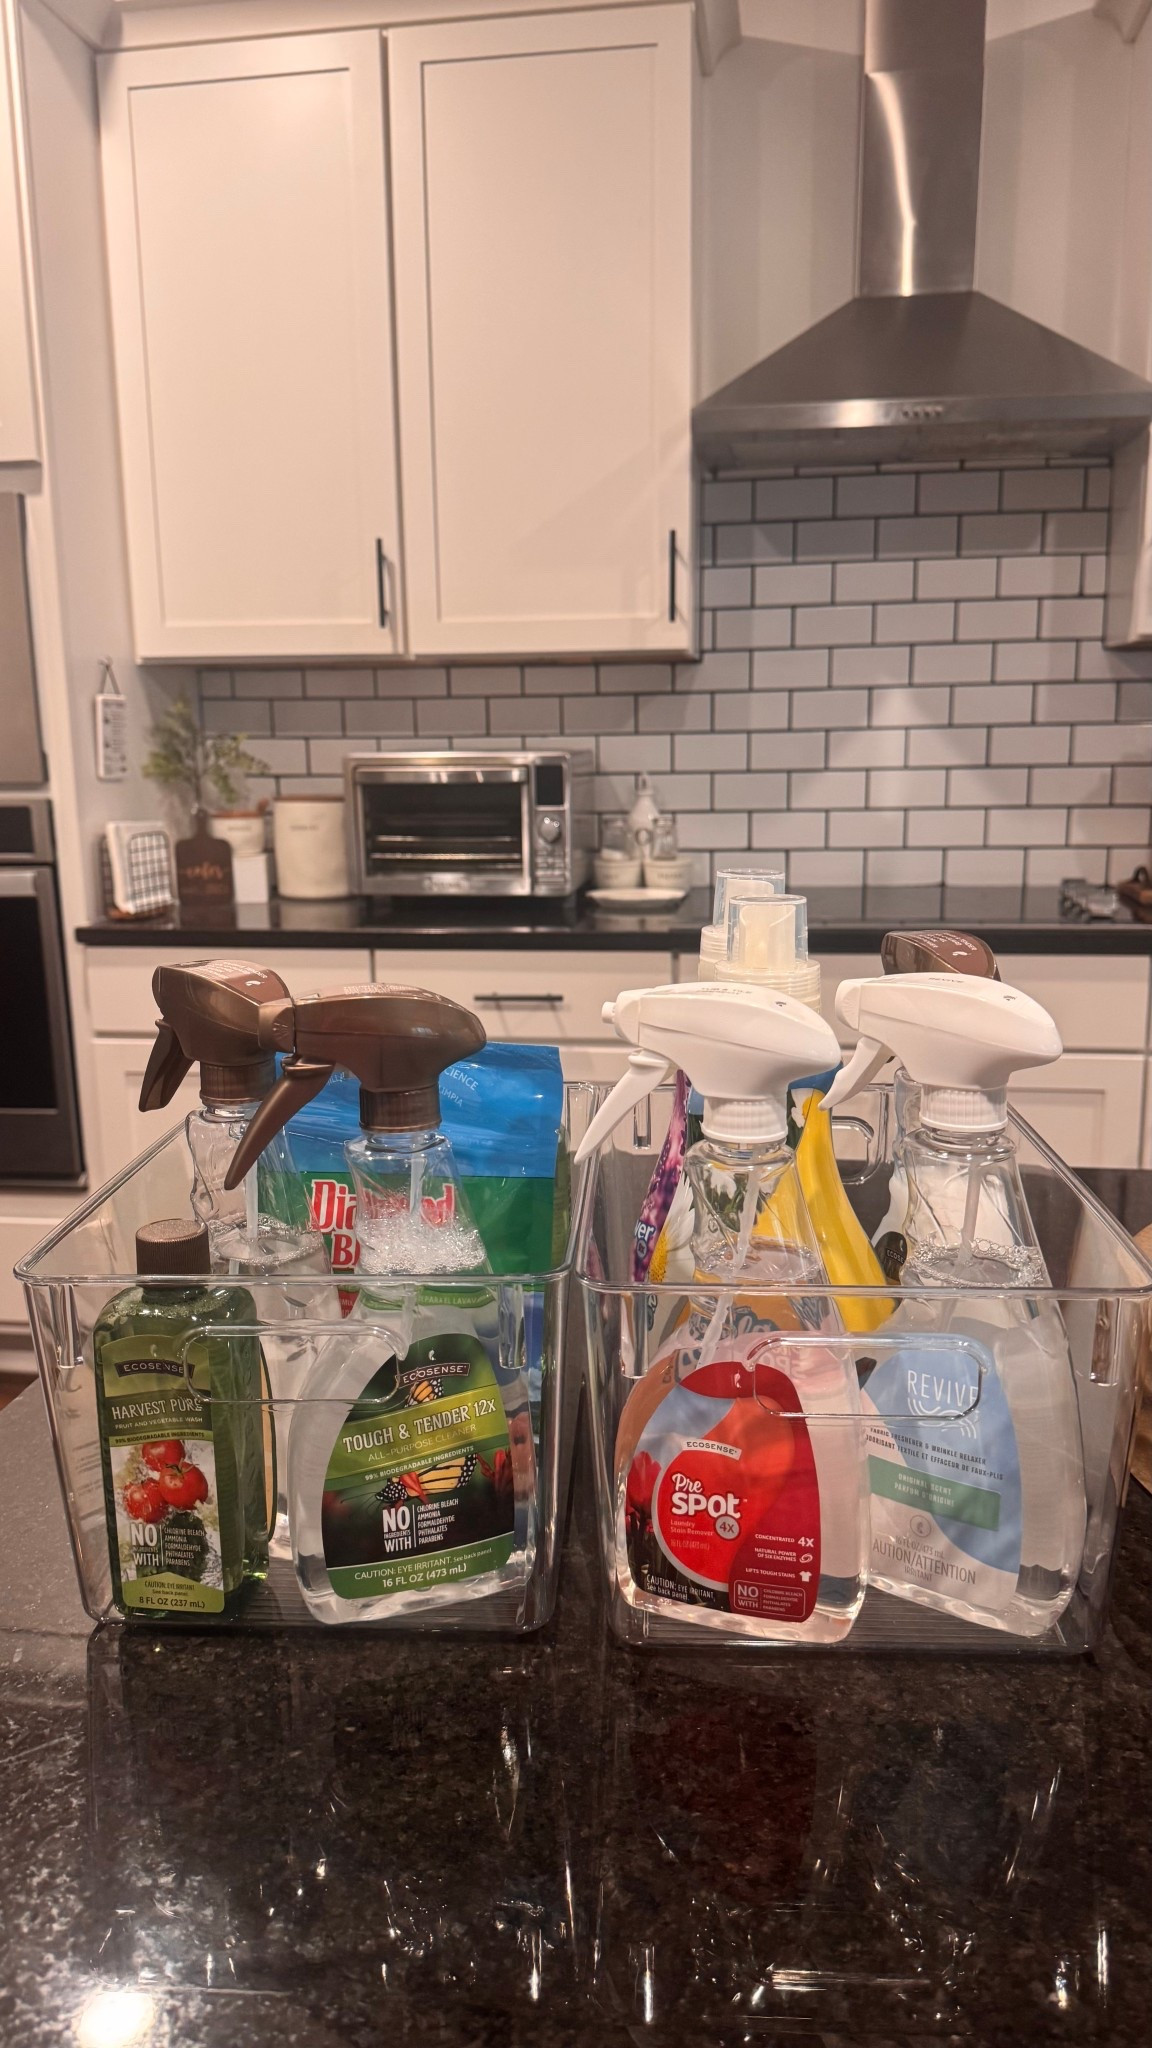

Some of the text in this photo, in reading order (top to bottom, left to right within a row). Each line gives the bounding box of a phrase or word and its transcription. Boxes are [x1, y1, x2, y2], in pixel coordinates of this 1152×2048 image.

[444, 1068, 479, 1091] CIENCE
[123, 1362, 184, 1374] ECOSENSE
[403, 1365, 465, 1384] ECOSENSE
[111, 1401, 166, 1420] HARVEST
[343, 1427, 393, 1453] TOUGH
[399, 1423, 411, 1440] &
[414, 1405, 471, 1436] TENDER
[368, 1424, 477, 1462] ALL-PURPOSE CLEANER
[686, 1441, 735, 1456] ECOSENSE
[379, 1457, 432, 1477] BIODEGRADABLE
[433, 1445, 474, 1462] INGREDIENTS
[931, 1445, 957, 1457] WRINKLE
[959, 1453, 986, 1465] RELAXER
[930, 1456, 960, 1469] EFFACEUR
[671, 1473, 703, 1493] Pre
[417, 1498, 459, 1512] CHLORINE BLEACH
[382, 1506, 411, 1533] NO
[417, 1510, 441, 1520] AMMONIA
[417, 1515, 455, 1528] FORMALDEHYDE
[418, 1525, 448, 1536] PHTHALATES
[670, 1520, 696, 1528] Laundry
[130, 1523, 158, 1547] NO
[418, 1534, 444, 1545] PARABENS
[755, 1534, 795, 1543] CONCENTRATED
[384, 1536, 412, 1553] WITH
[133, 1553, 159, 1566] WITH
[354, 1567, 396, 1581] CAUTION:
[398, 1564, 413, 1574] EYE
[464, 1552, 476, 1560] back
[872, 1538, 976, 1585] AUTION/ATTENTION
[382, 1563, 467, 1588] 16 FL OZ (473 mL)
[646, 1583, 656, 1592] See
[657, 1587, 671, 1596] back
[677, 1585, 688, 1593] EYE
[737, 1584, 759, 1598] NO
[139, 1596, 205, 1609] 8 FL OZ (237 mL)
[737, 1599, 759, 1608] WITH
